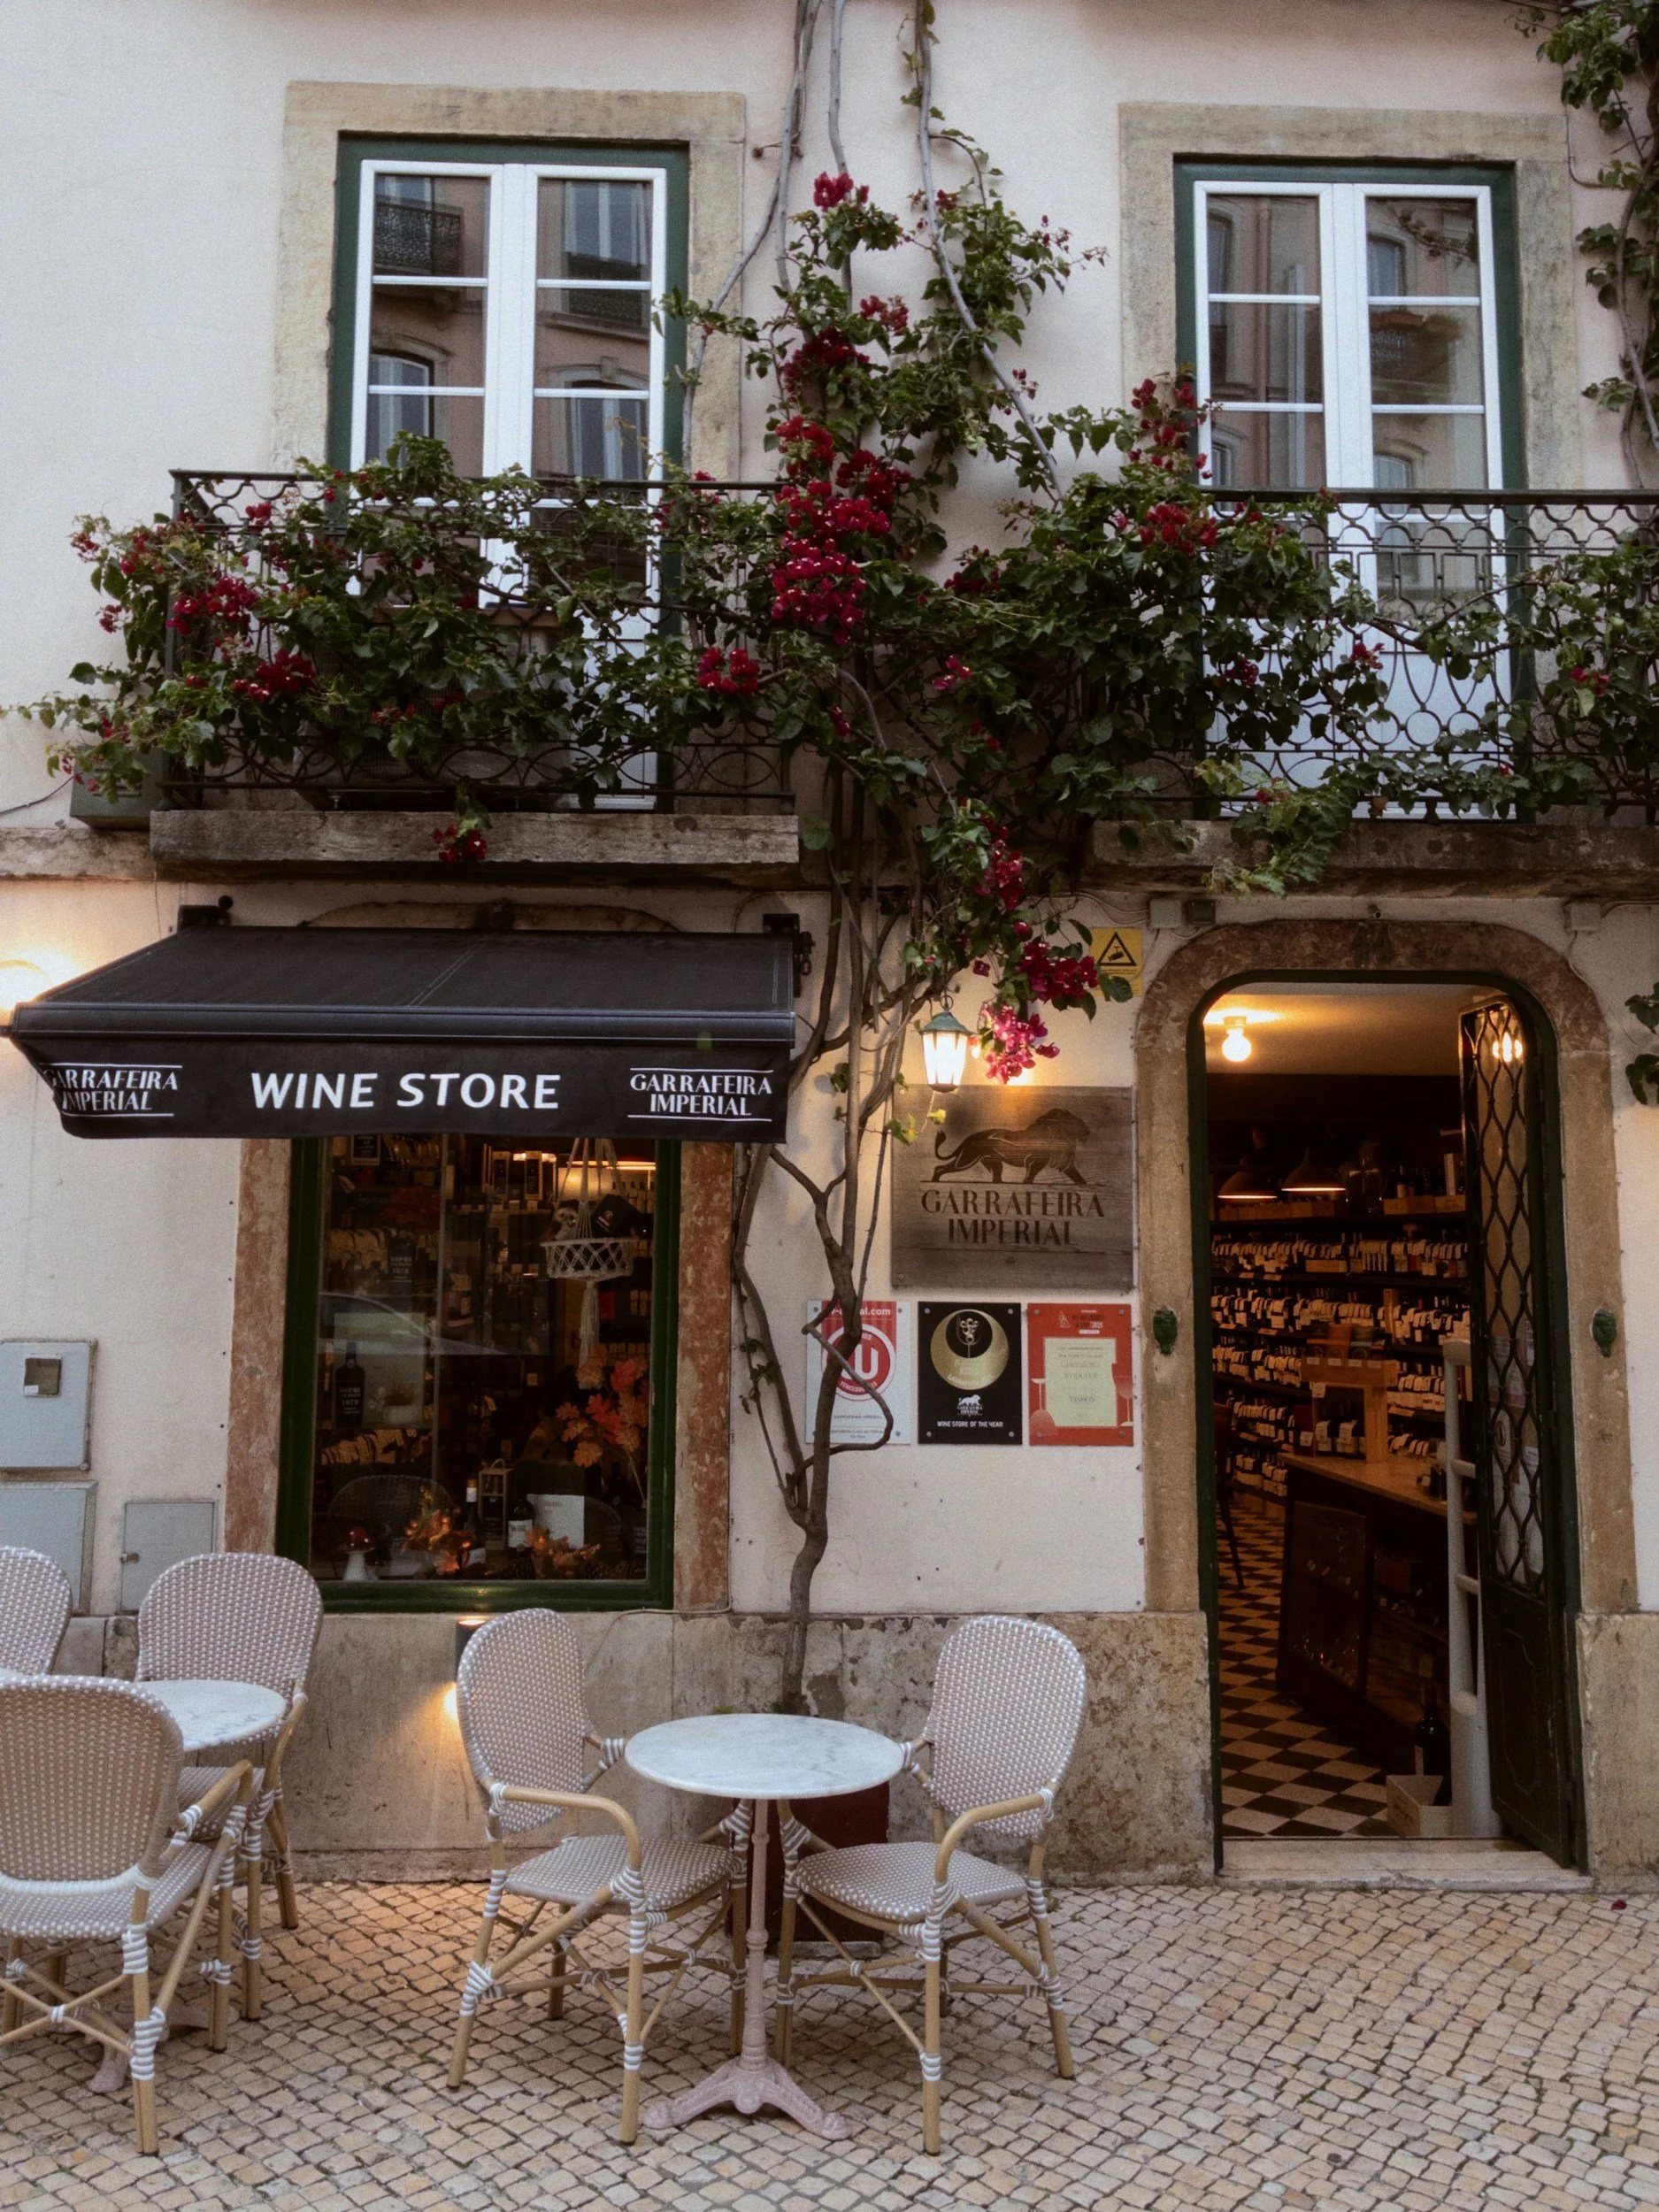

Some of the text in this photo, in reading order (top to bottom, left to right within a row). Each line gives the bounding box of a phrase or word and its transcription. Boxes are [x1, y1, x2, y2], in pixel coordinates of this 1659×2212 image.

[44, 1069, 178, 1090] GARRAFEIRA
[251, 1072, 561, 1109] WINE STORE
[630, 1073, 772, 1094] GARRAFEIRA
[62, 1090, 152, 1111] IMPERIAL
[650, 1093, 752, 1116] IMPERIAL
[921, 1189, 1105, 1217] GARRAFEIRA
[948, 1218, 1078, 1246] IMPERIAL
